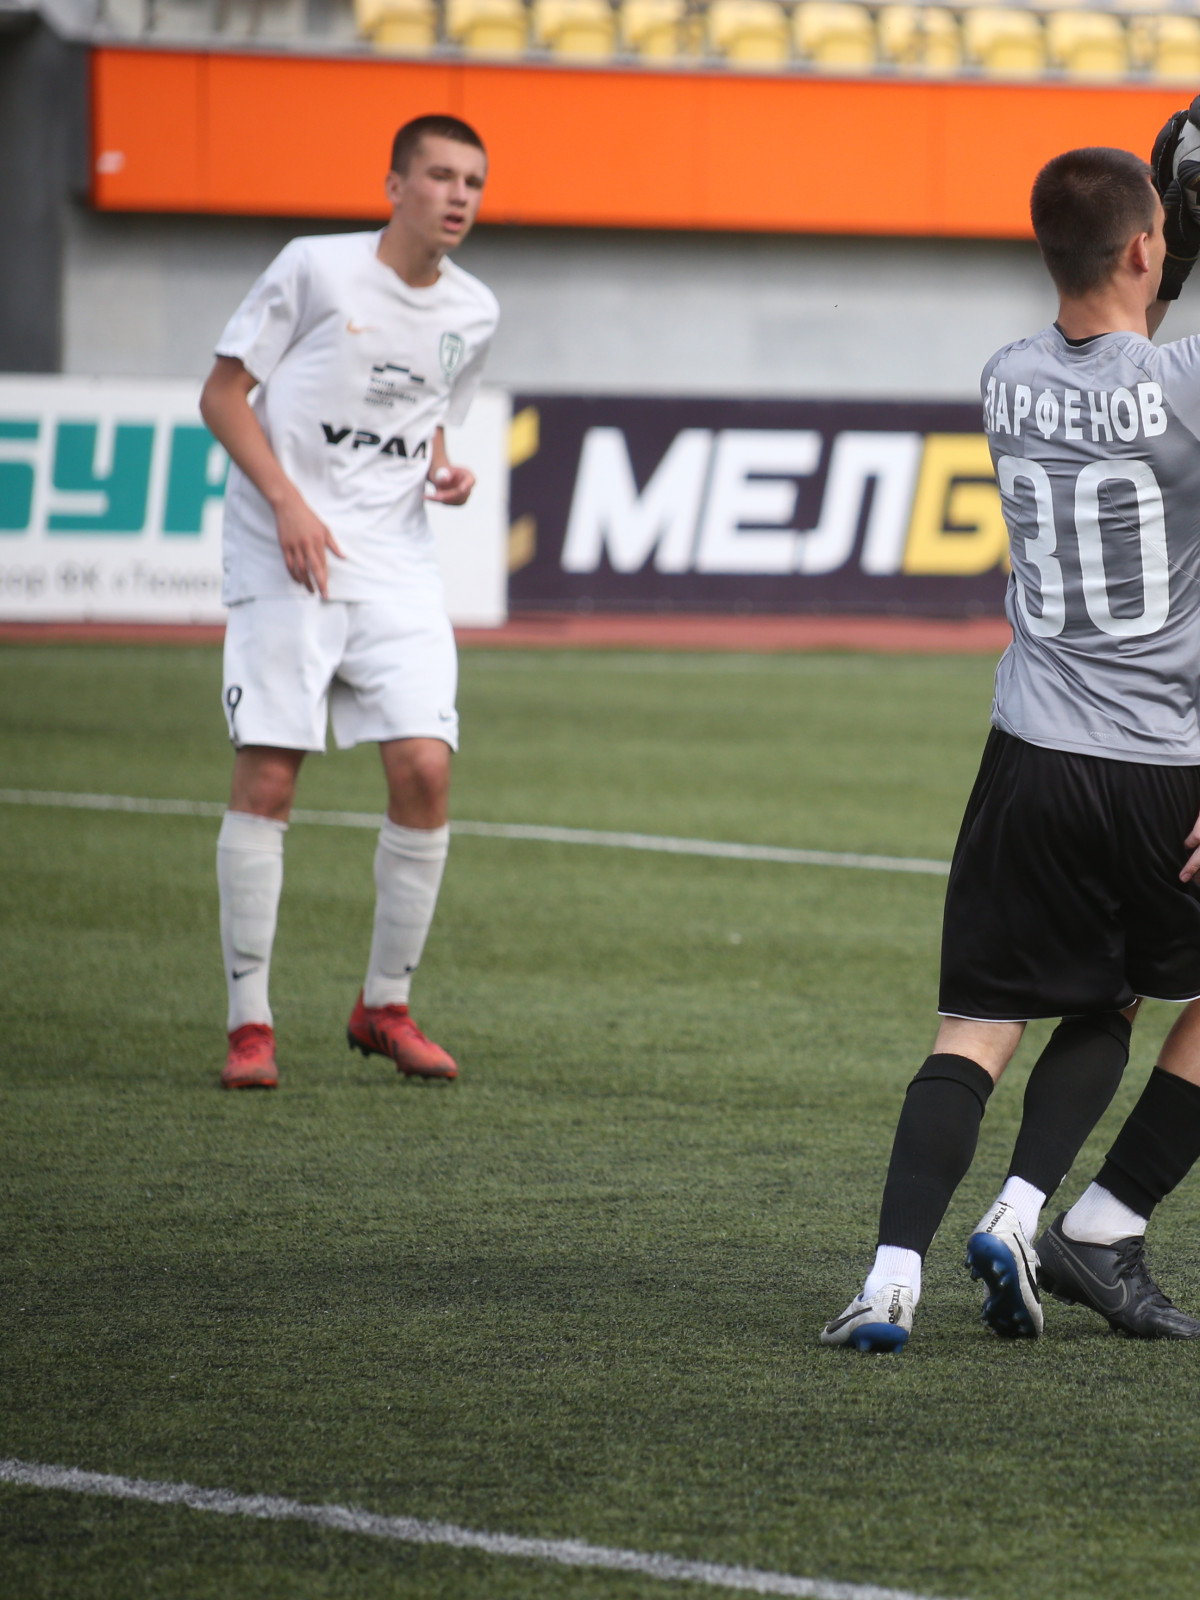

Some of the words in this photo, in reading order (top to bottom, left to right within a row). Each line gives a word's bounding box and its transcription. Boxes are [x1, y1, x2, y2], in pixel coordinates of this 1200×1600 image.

[983, 376, 1168, 443] ПАРФЕНОВ
[561, 426, 1010, 576] МЕЛБ
[997, 455, 1170, 638] 30
